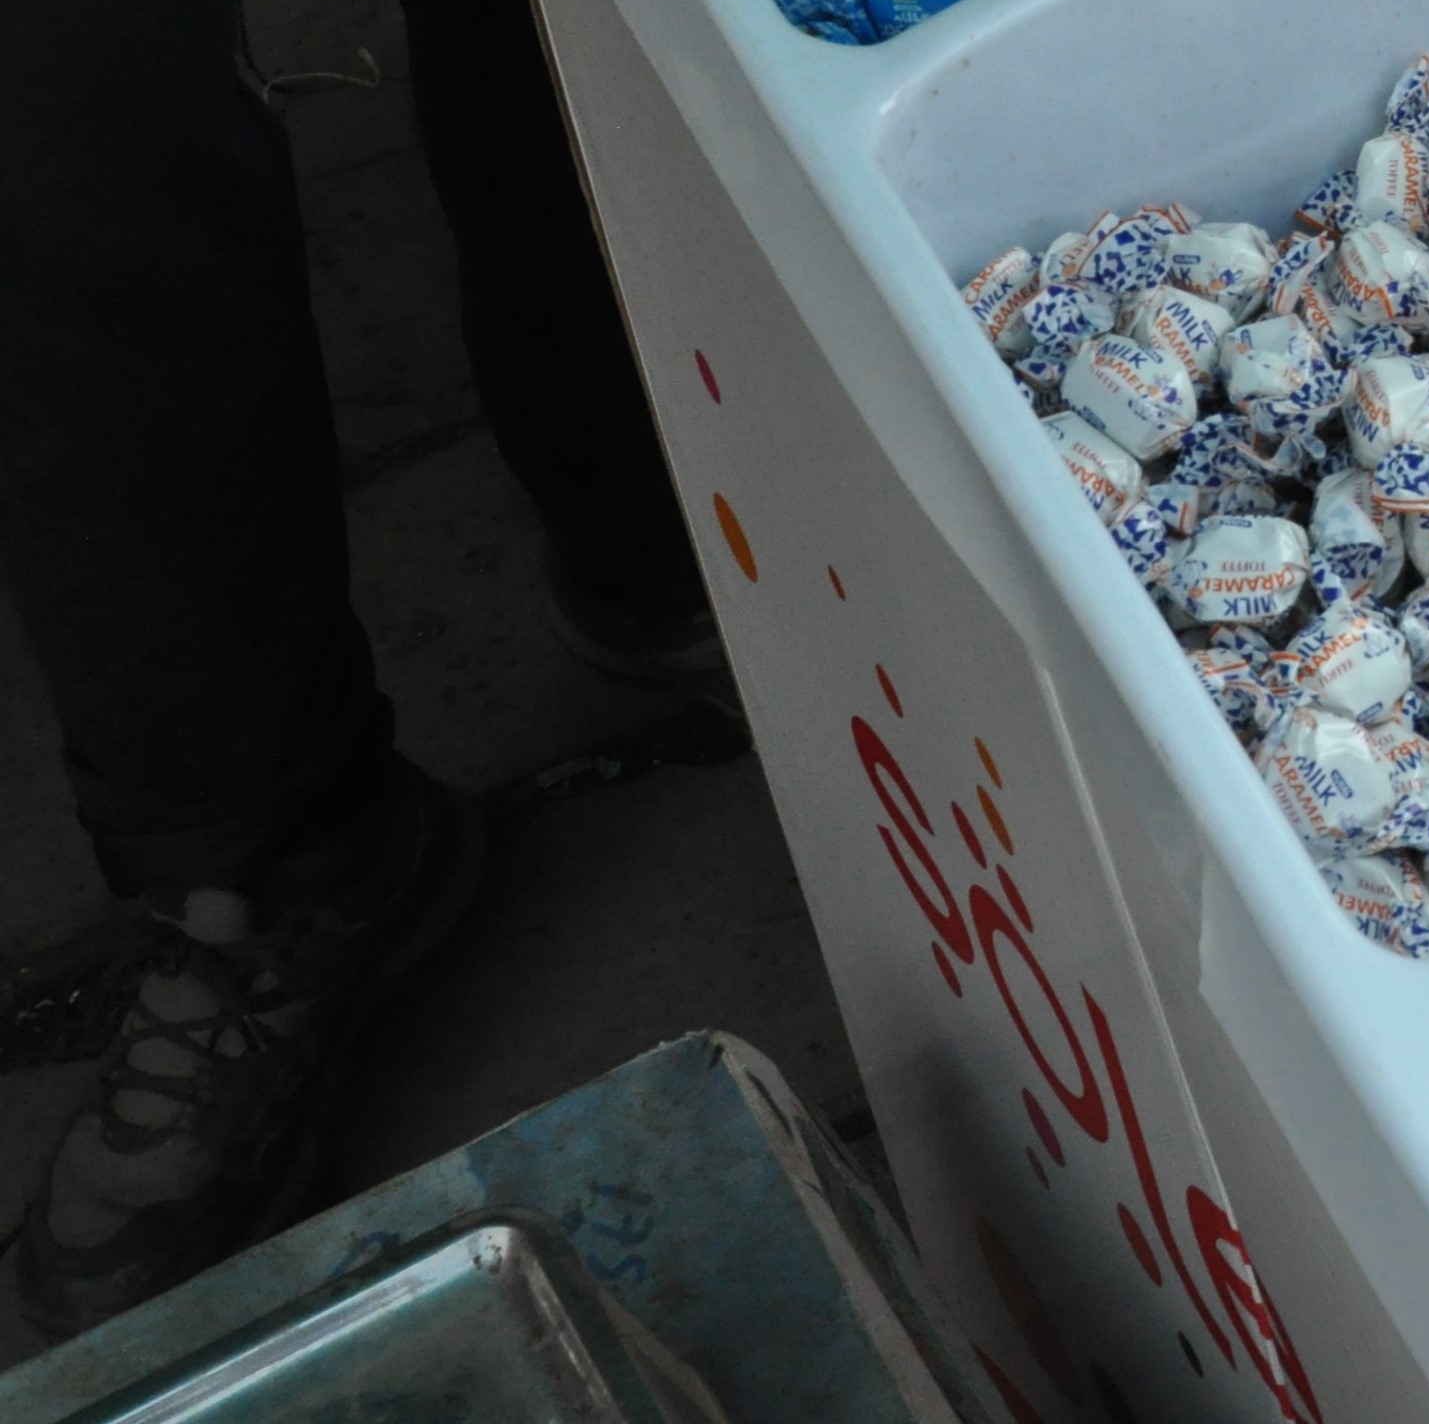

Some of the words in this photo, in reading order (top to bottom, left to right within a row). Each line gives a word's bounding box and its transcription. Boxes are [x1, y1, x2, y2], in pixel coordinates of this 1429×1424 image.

[972, 281, 1015, 322] MILK
[1165, 302, 1209, 351] MILK
[1100, 341, 1148, 369] MILK
[1202, 567, 1296, 594] CARAMEL
[1219, 561, 1267, 572] TOFFEE
[1224, 597, 1278, 616] MILK
[1293, 755, 1337, 807] MILK
